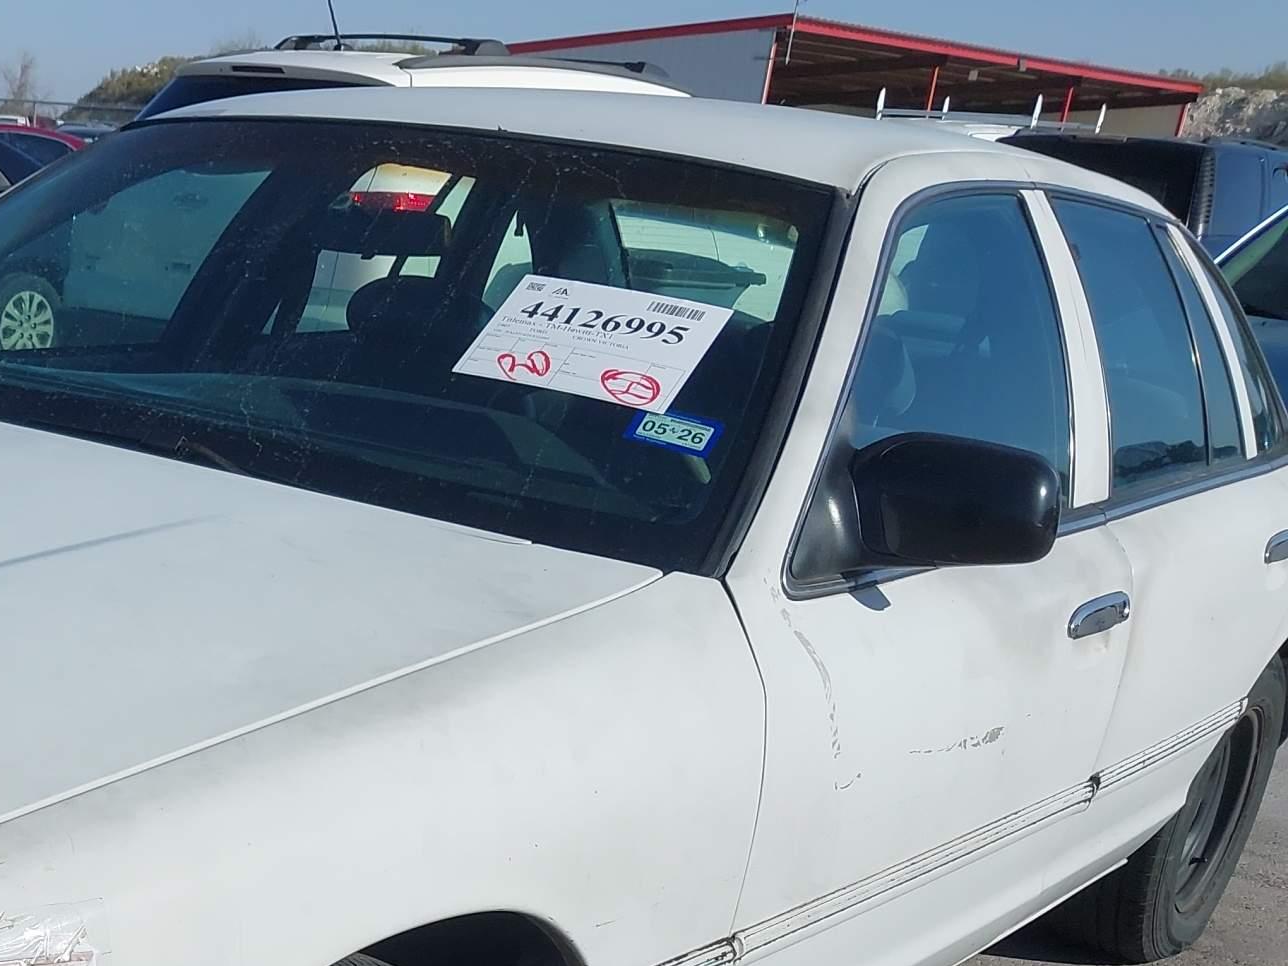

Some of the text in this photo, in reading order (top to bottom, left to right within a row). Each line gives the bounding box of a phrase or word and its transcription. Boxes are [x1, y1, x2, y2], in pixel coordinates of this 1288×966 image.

[520, 301, 691, 345] 44126995
[642, 420, 706, 444] 05 26
